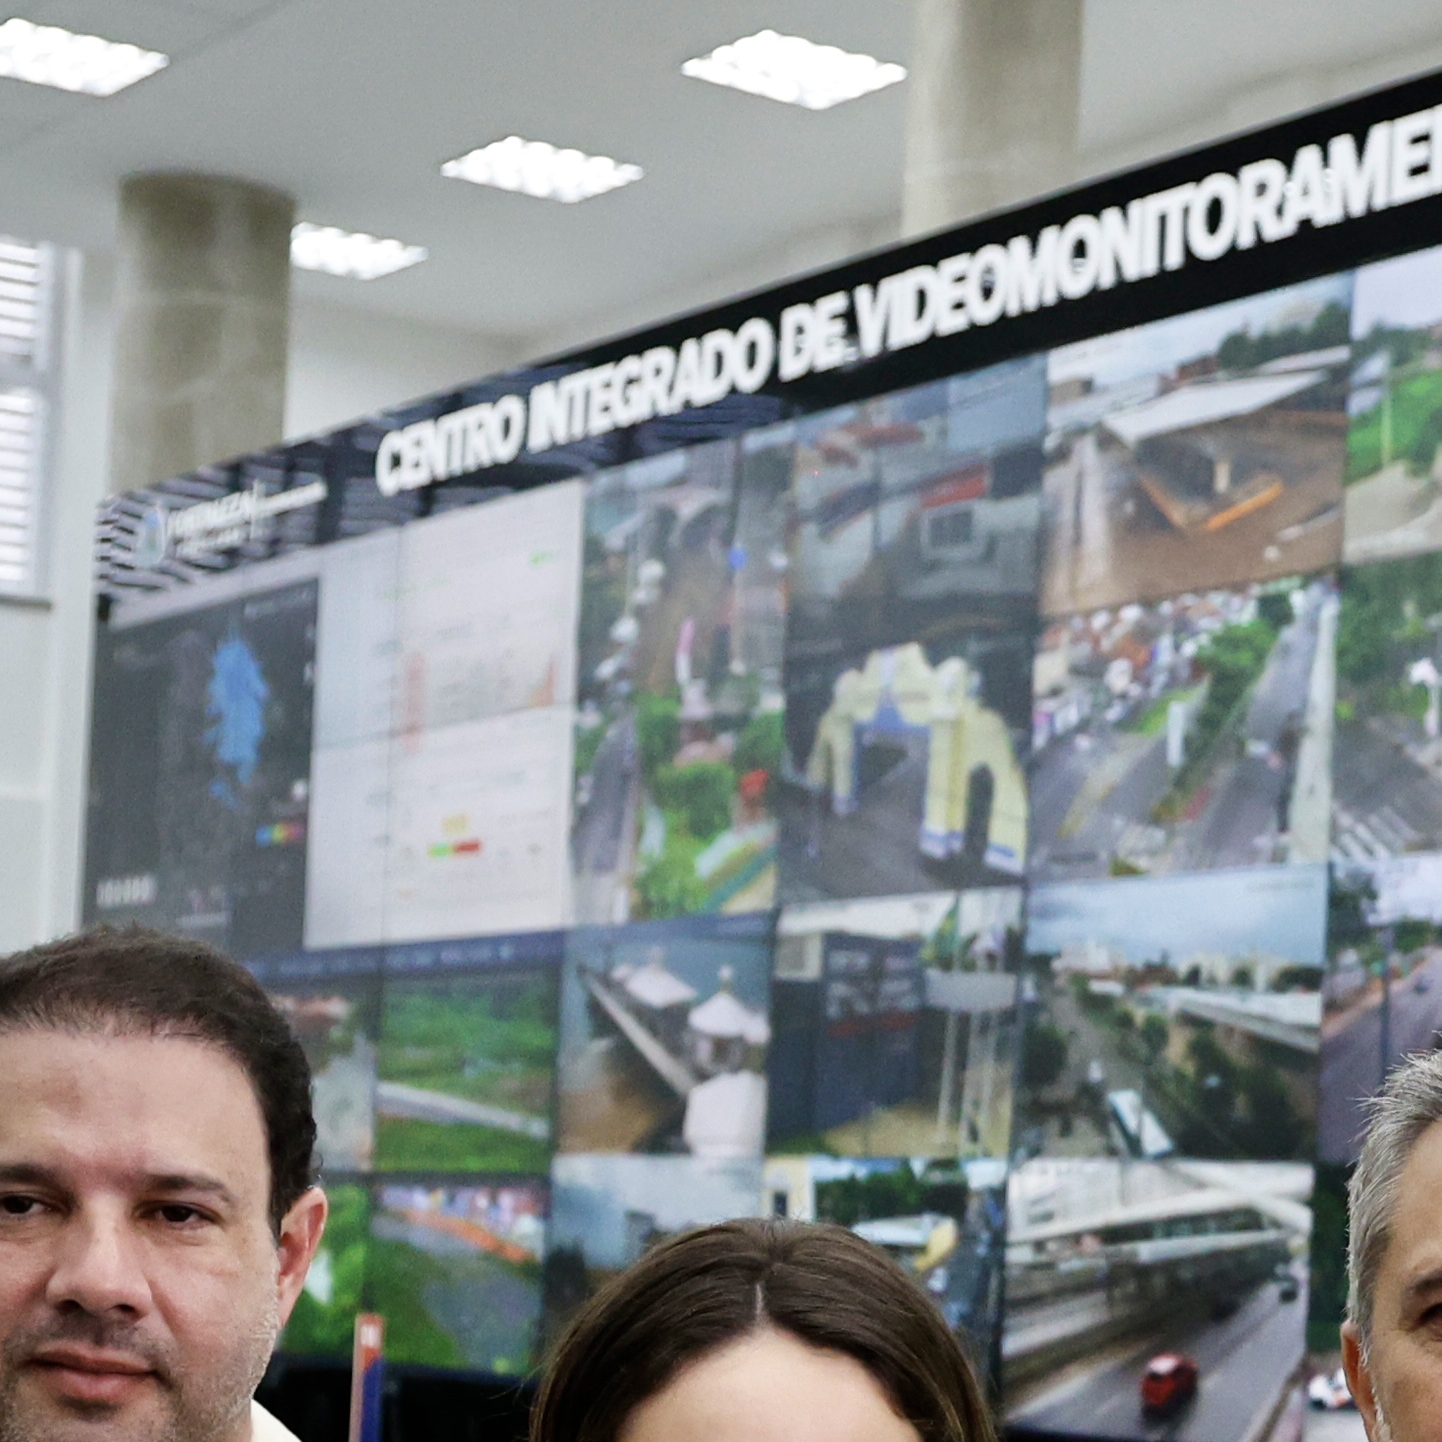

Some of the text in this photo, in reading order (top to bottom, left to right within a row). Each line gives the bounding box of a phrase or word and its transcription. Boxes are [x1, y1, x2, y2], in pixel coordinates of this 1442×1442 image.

[375, 394, 526, 497] CENTRO
[526, 317, 775, 453] INTEGRADO
[777, 290, 849, 383] DE
